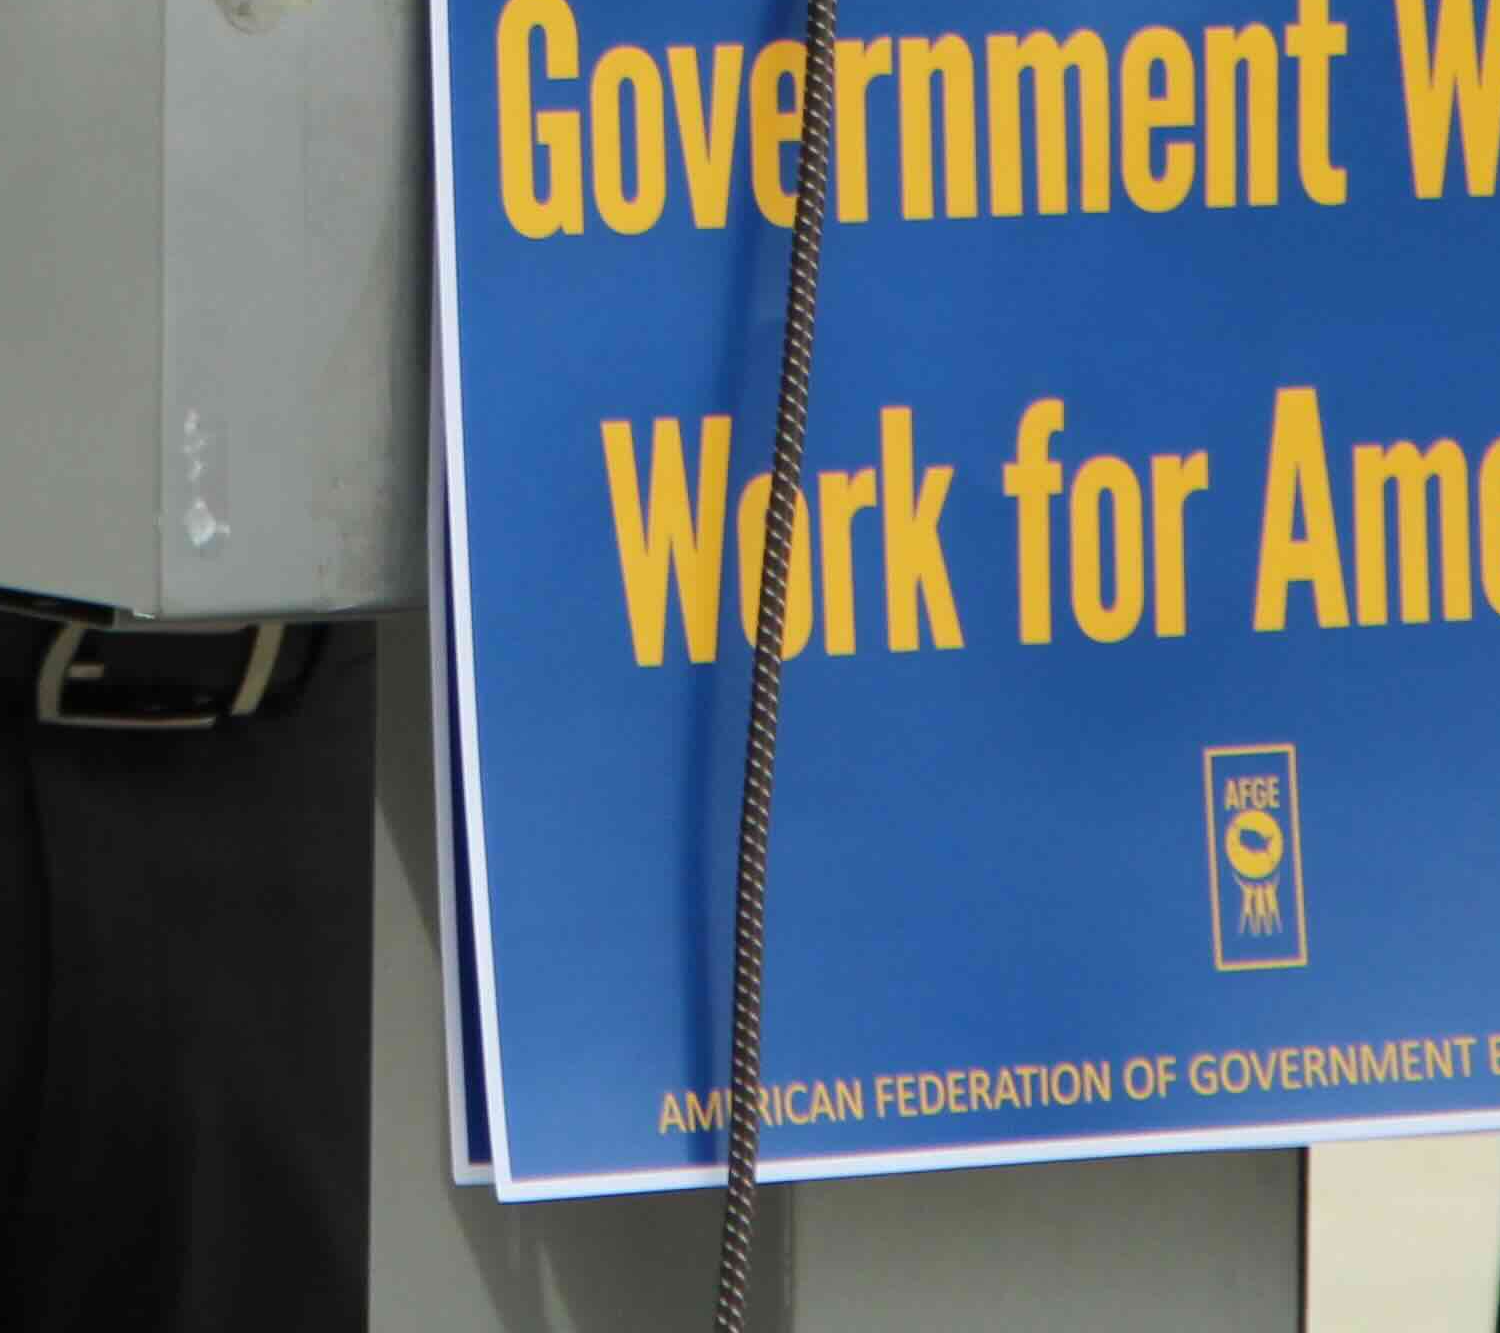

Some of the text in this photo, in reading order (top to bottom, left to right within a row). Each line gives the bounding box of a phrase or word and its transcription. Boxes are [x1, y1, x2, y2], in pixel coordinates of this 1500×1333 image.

[601, 405, 965, 668] Work
[1002, 397, 1208, 647] for
[1223, 775, 1280, 811] AFGE
[659, 1078, 865, 1136] AMRICAN
[874, 1059, 1113, 1119] FEDERATION
[1122, 1053, 1178, 1101] OF
[1187, 1035, 1477, 1098] GOVERNMENT
